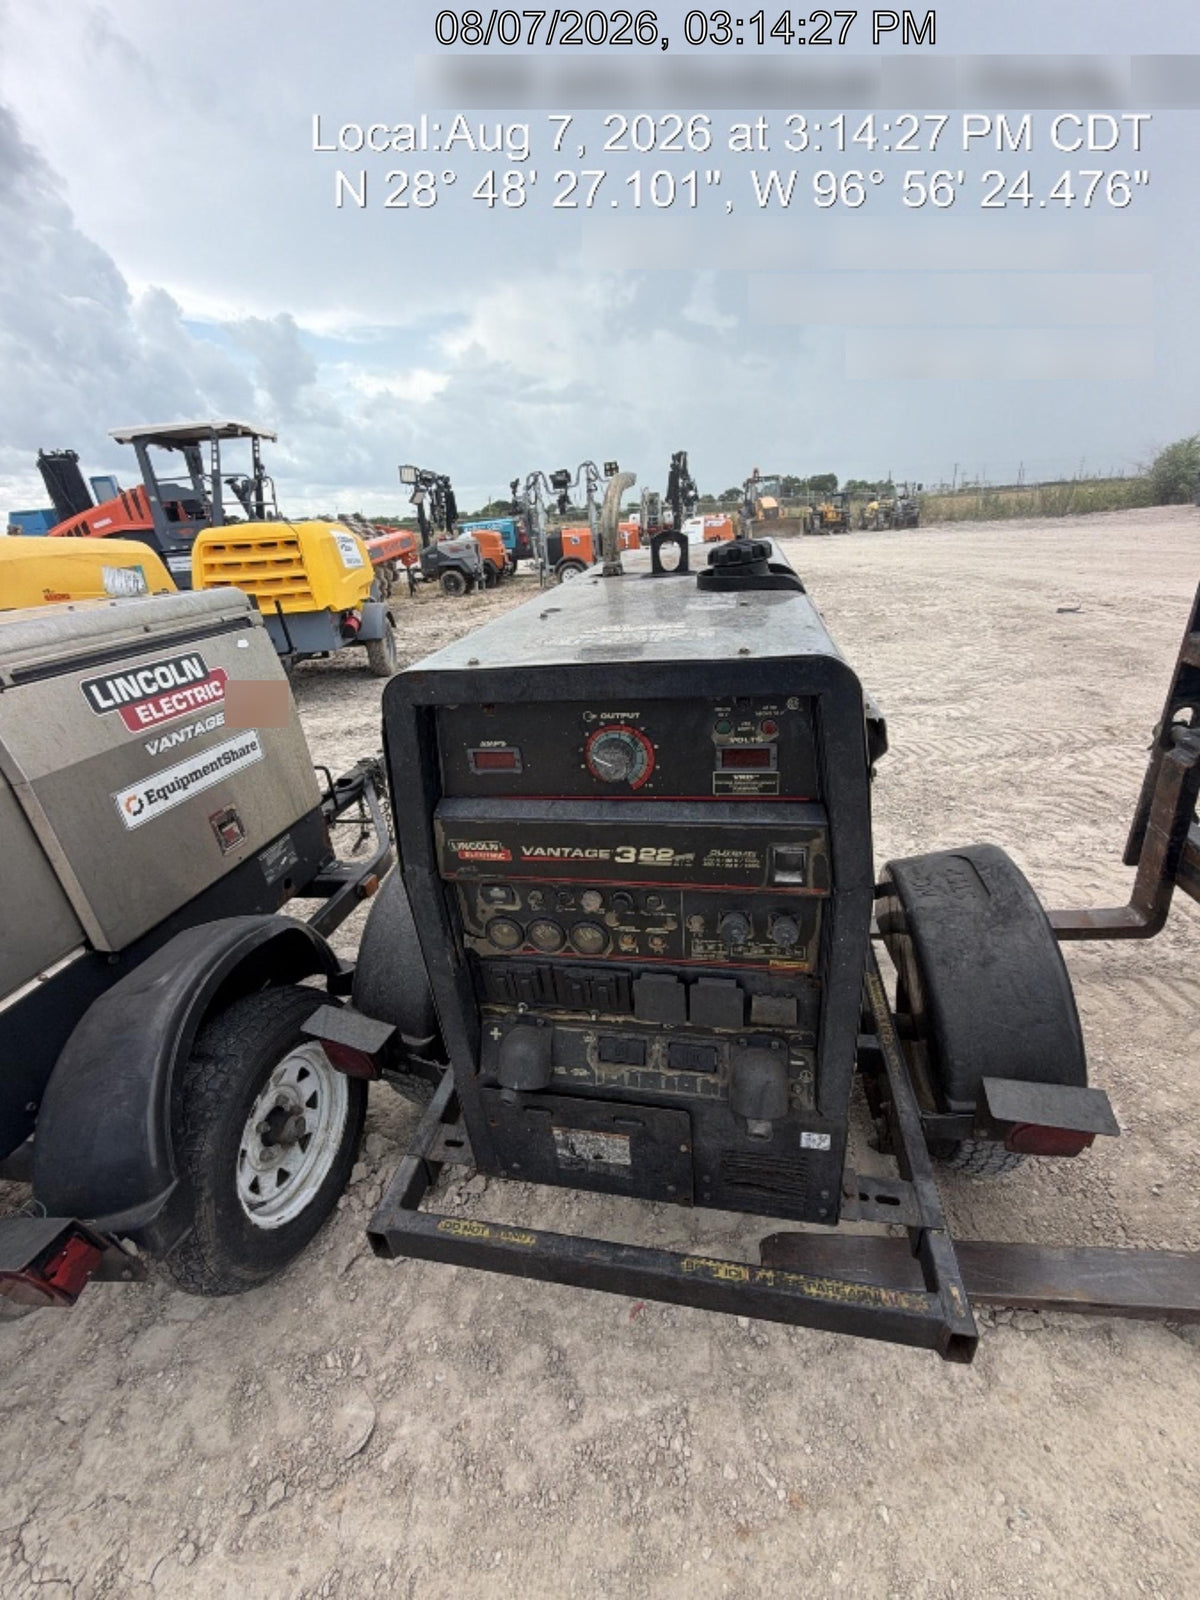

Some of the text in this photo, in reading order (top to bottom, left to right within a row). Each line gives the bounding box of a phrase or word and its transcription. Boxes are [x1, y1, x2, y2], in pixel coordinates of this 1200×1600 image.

[90, 657, 204, 709] LINCOLN
[135, 680, 224, 724] ELECTRIC
[144, 712, 225, 756] VANTAGE
[143, 739, 258, 806] EquipmentShare
[521, 846, 611, 860] VANTAGE
[614, 845, 675, 864] 322
